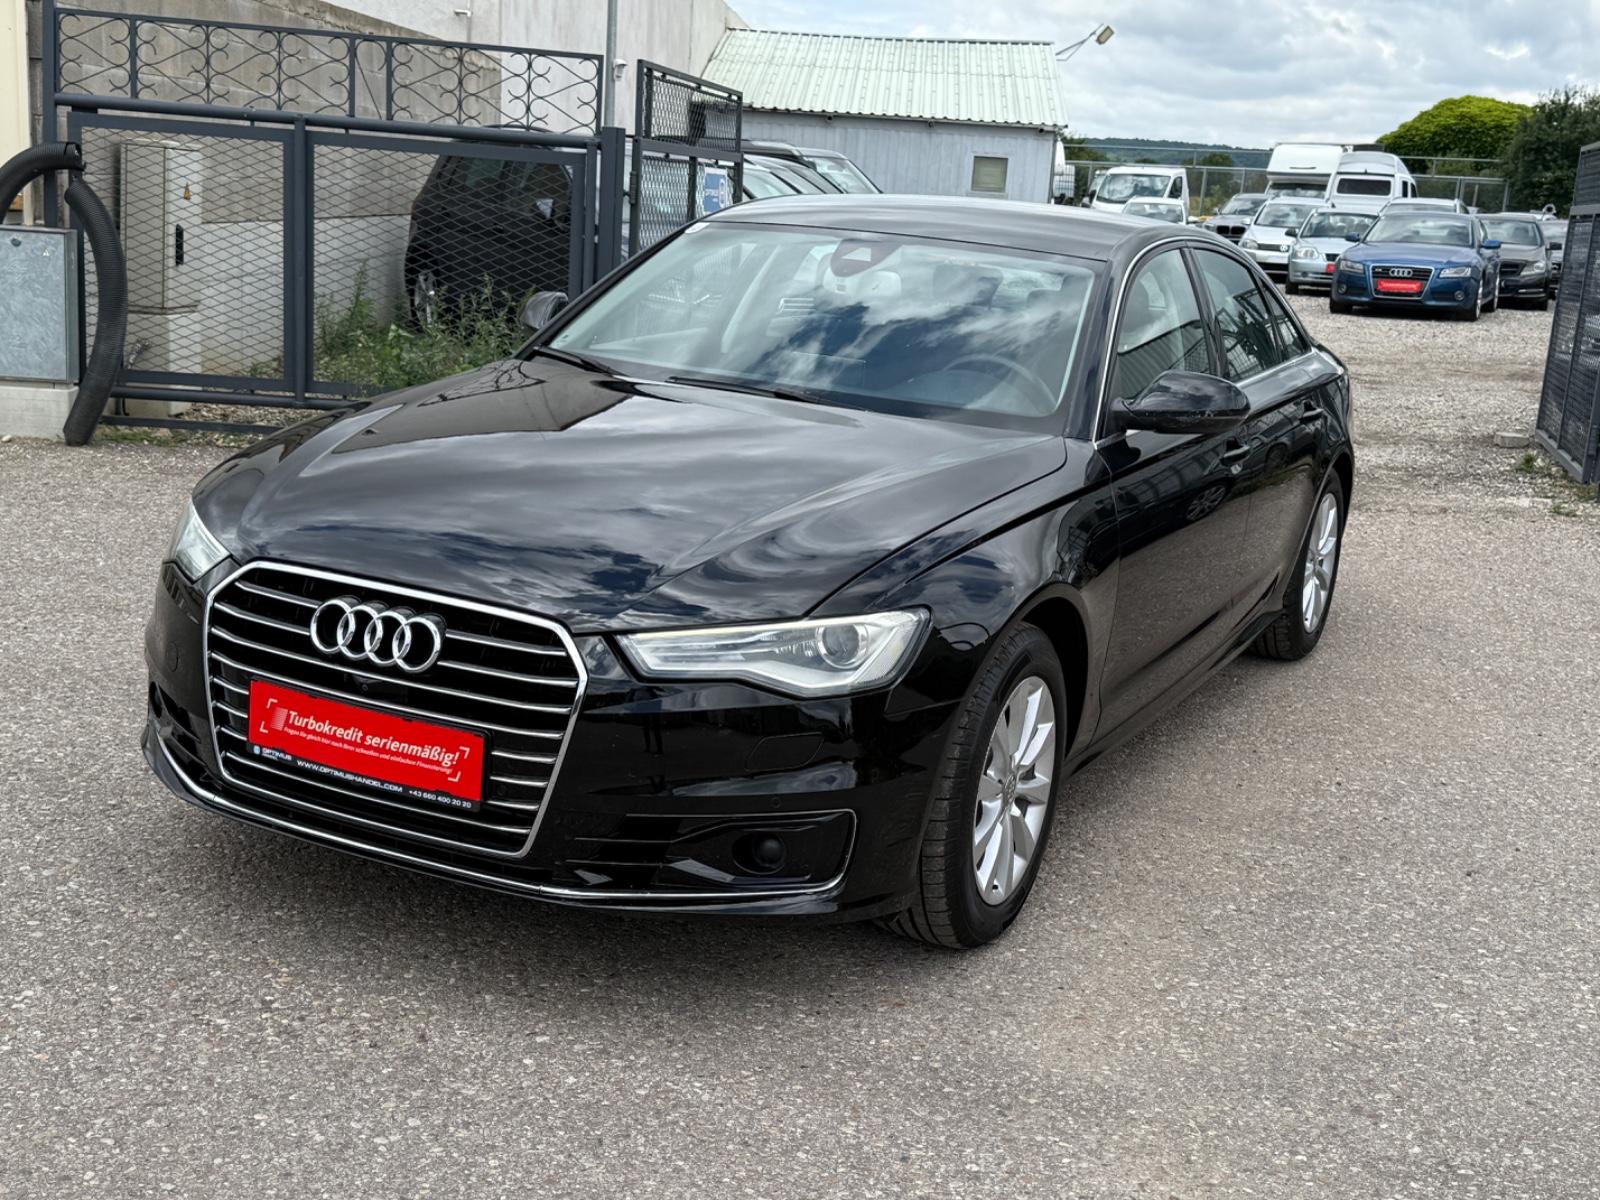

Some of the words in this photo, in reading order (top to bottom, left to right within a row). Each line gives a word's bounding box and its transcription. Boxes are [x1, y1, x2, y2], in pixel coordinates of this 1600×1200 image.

[288, 710, 364, 744] Turbokredit
[363, 735, 460, 768] serienmäßig!
[296, 759, 403, 793] WWW.OPTIMUSHANDEL.COM
